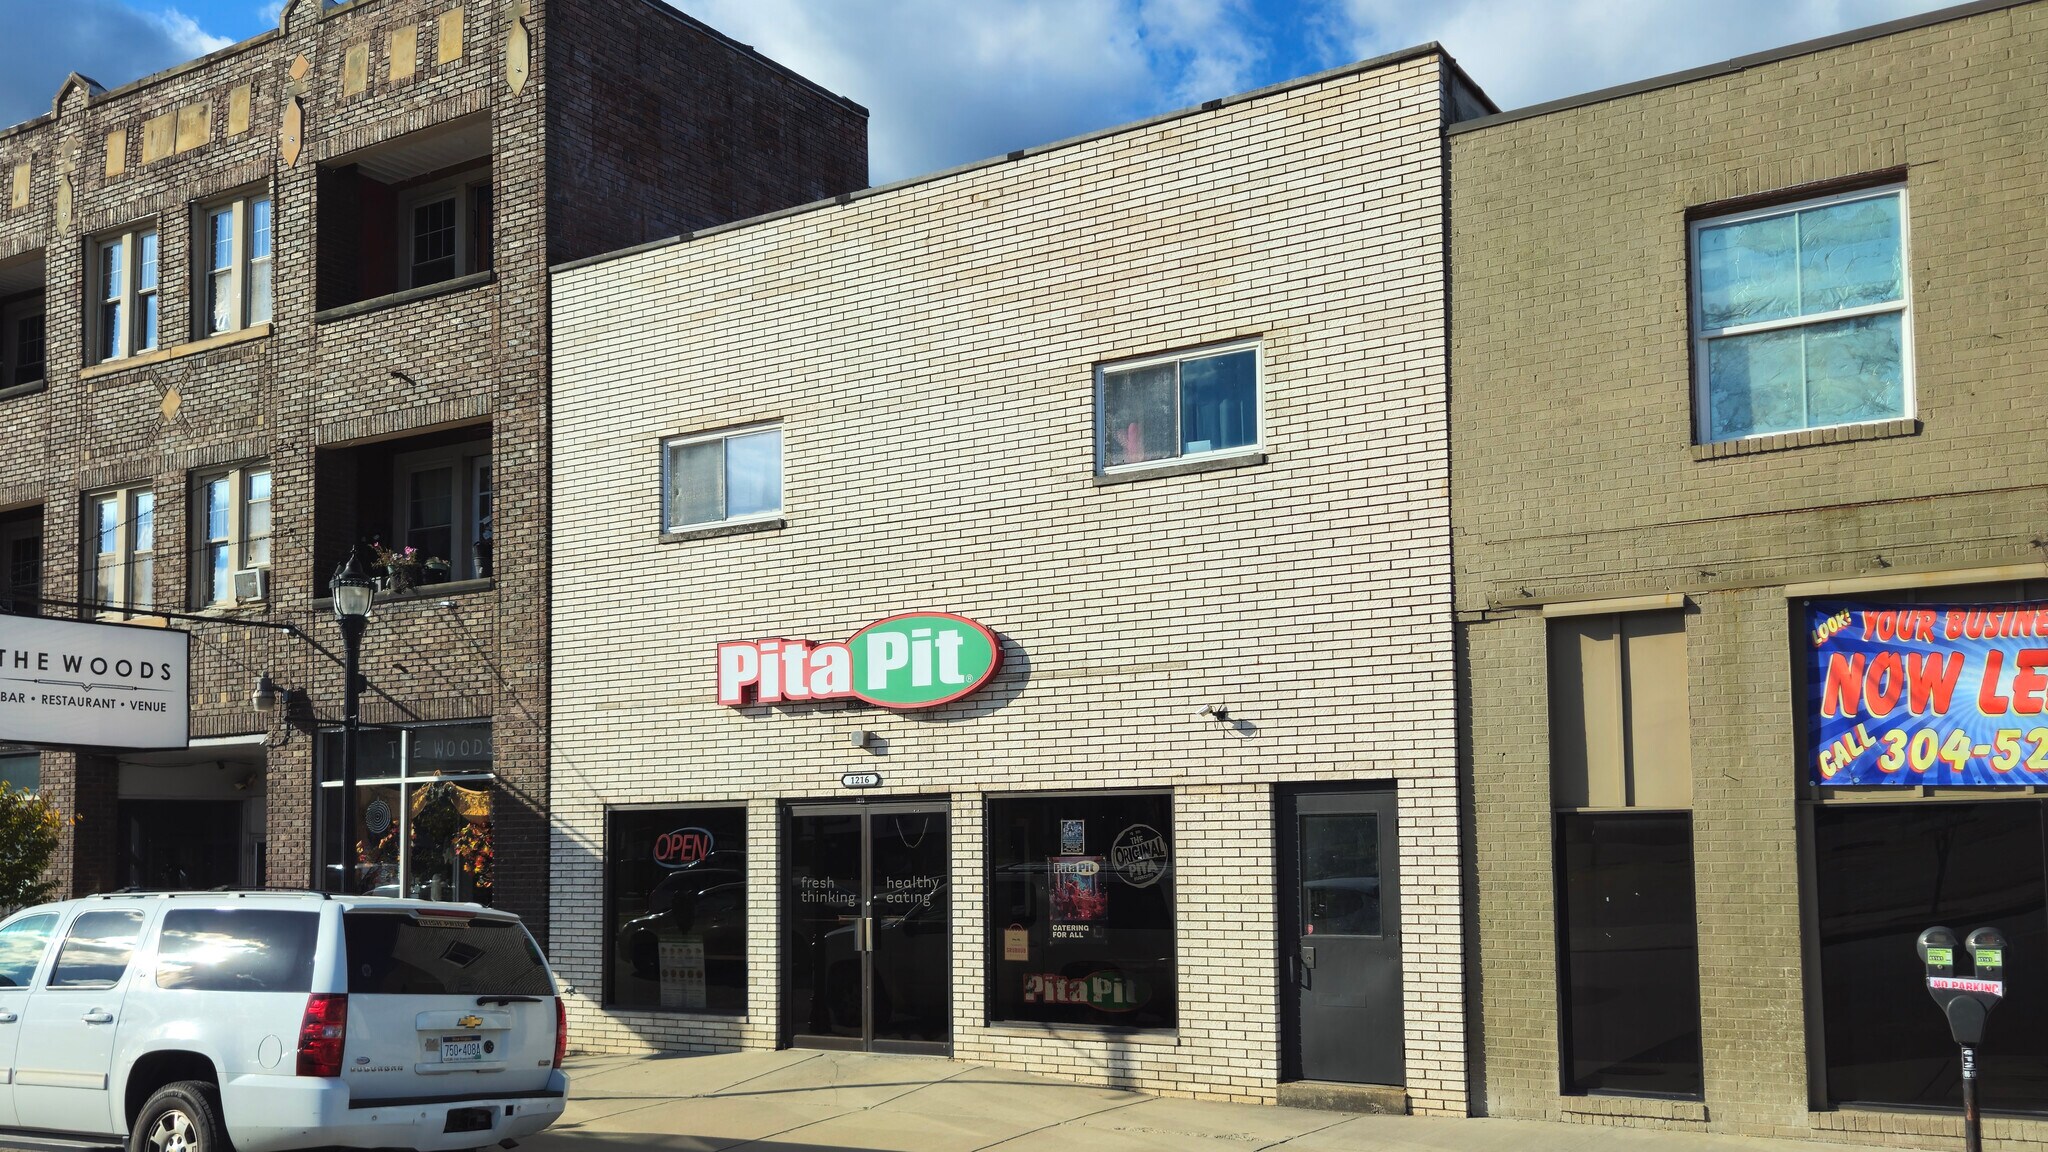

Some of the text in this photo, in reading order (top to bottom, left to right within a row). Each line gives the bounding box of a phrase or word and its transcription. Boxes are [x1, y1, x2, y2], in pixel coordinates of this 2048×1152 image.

[1812, 607, 1852, 647] LOOK!
[1861, 608, 1938, 644] YOUR
[63, 654, 172, 681] WOODS
[719, 628, 965, 702] Pita Pit
[1820, 648, 2048, 718] NOW LE
[0, 691, 167, 713] BAR RESTAURANT VENUE
[388, 740, 422, 760] TE
[1818, 723, 2048, 779] CALL 304-52
[850, 775, 870, 785] 1216
[655, 833, 709, 862] OPEN
[1115, 837, 1166, 867] ORIGINAL
[1130, 835, 1144, 845] THE
[1128, 860, 1159, 878] PITA
[801, 875, 940, 893] fresh healthy
[801, 890, 931, 907] thinking eating
[1052, 924, 1090, 932] CATERING
[1025, 975, 1138, 1003] Pita Pit
[1933, 980, 1949, 989] NO
